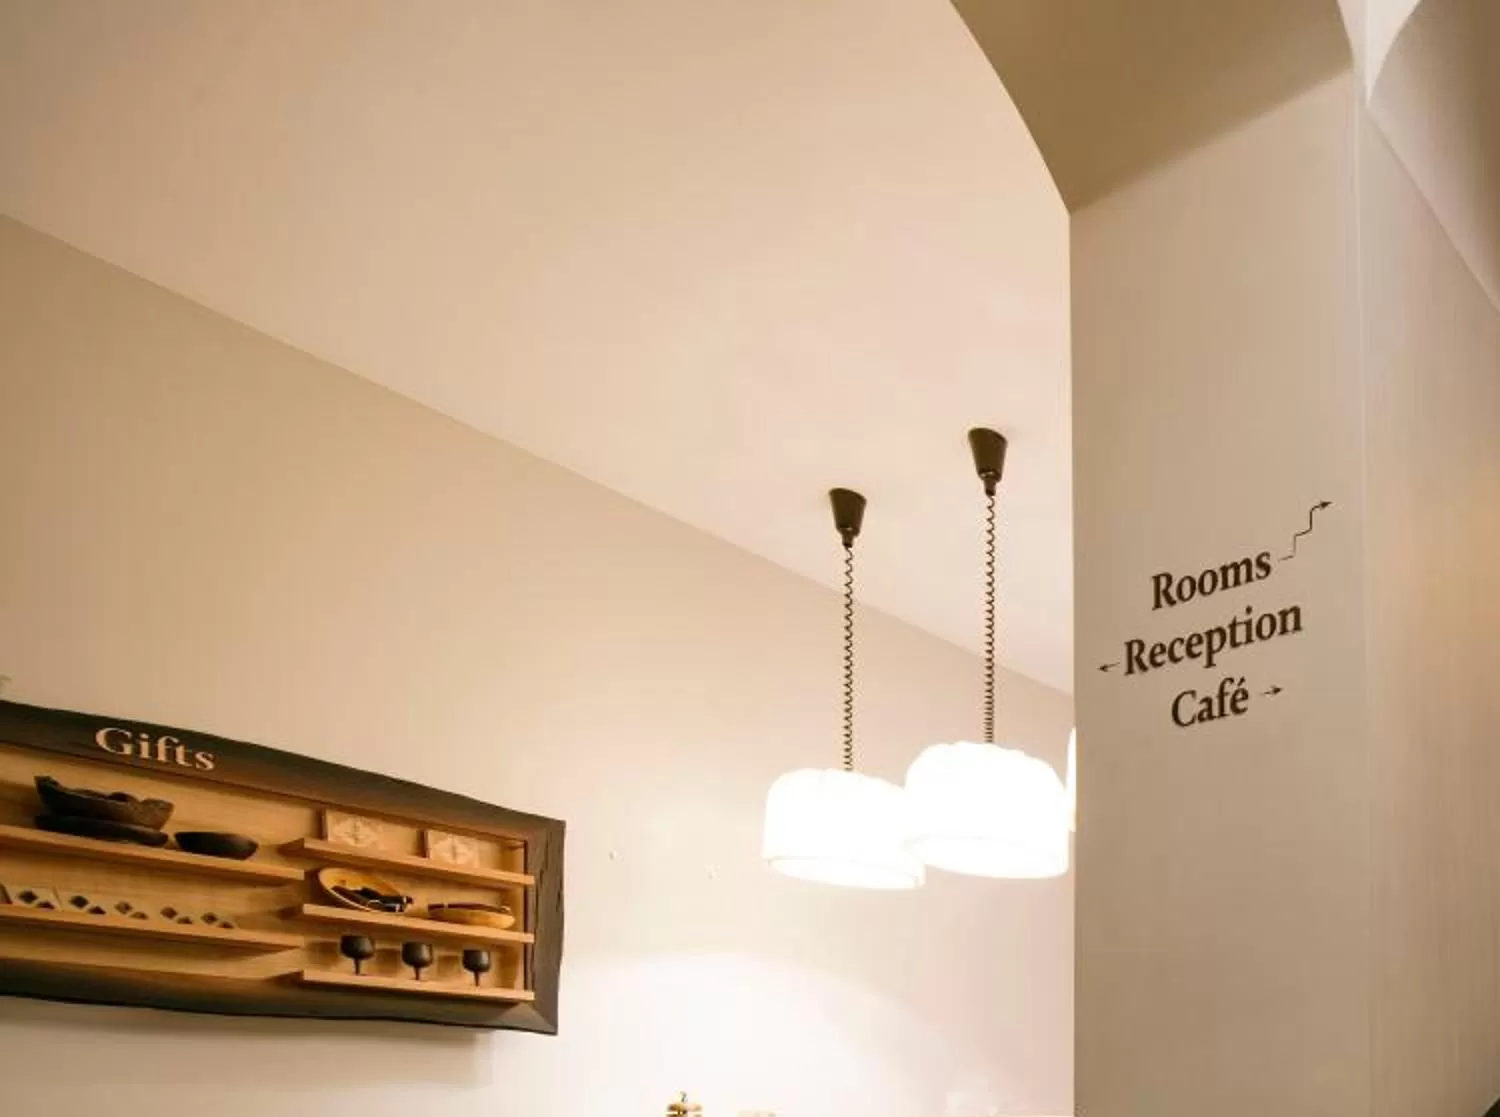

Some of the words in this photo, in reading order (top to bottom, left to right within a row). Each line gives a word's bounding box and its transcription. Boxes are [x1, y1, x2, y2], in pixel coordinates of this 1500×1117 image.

[1151, 551, 1272, 611] Rooms
[1124, 605, 1302, 675] Reception
[1171, 676, 1249, 728] Café
[95, 727, 215, 771] Gifts
